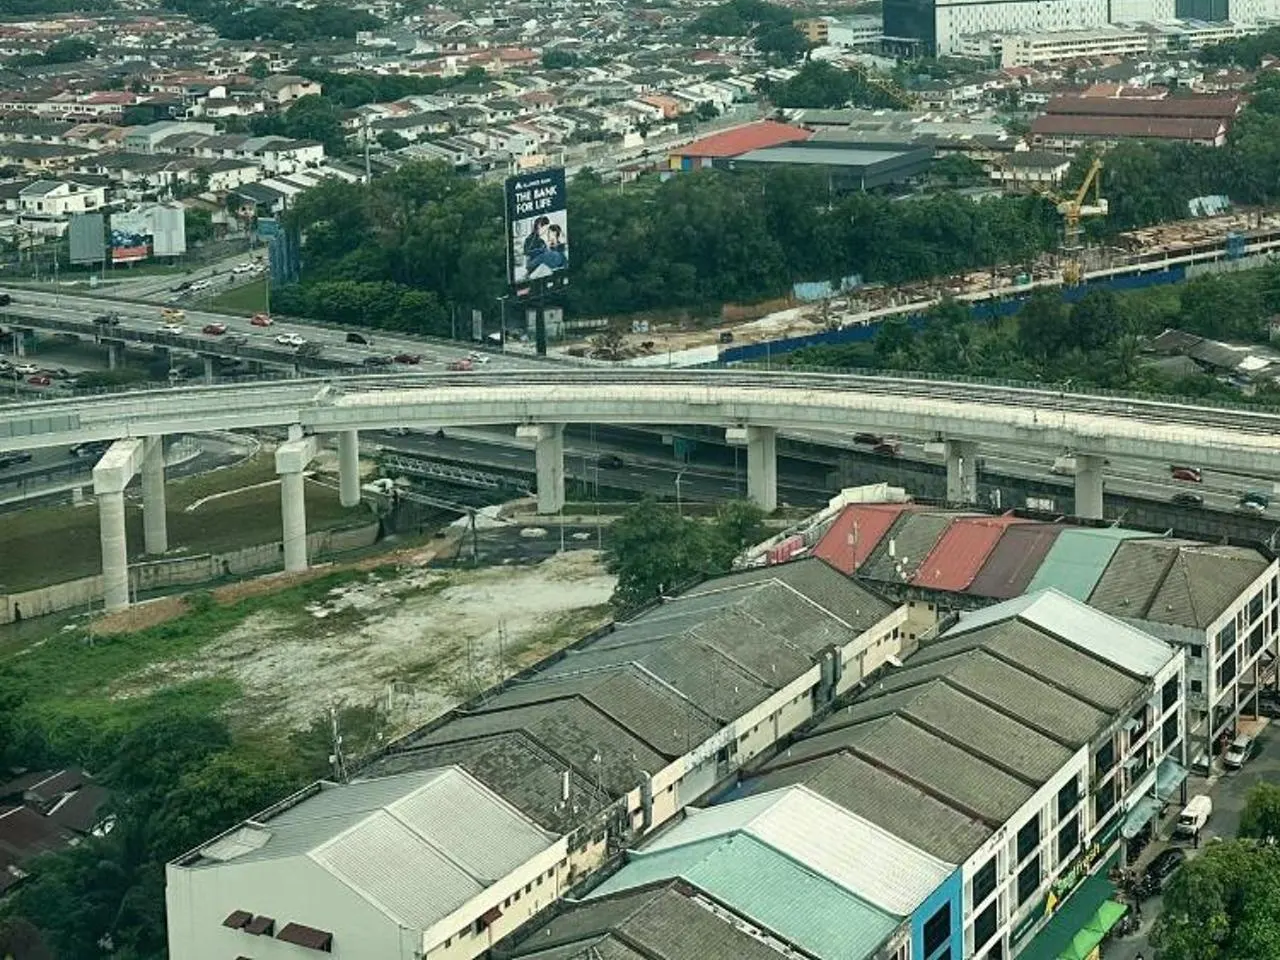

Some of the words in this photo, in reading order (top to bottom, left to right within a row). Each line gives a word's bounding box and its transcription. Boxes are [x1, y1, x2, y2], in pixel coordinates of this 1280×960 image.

[515, 190, 532, 203] THE
[533, 185, 558, 200] BANK
[516, 201, 533, 215] FOR
[535, 197, 552, 210] LIFE
